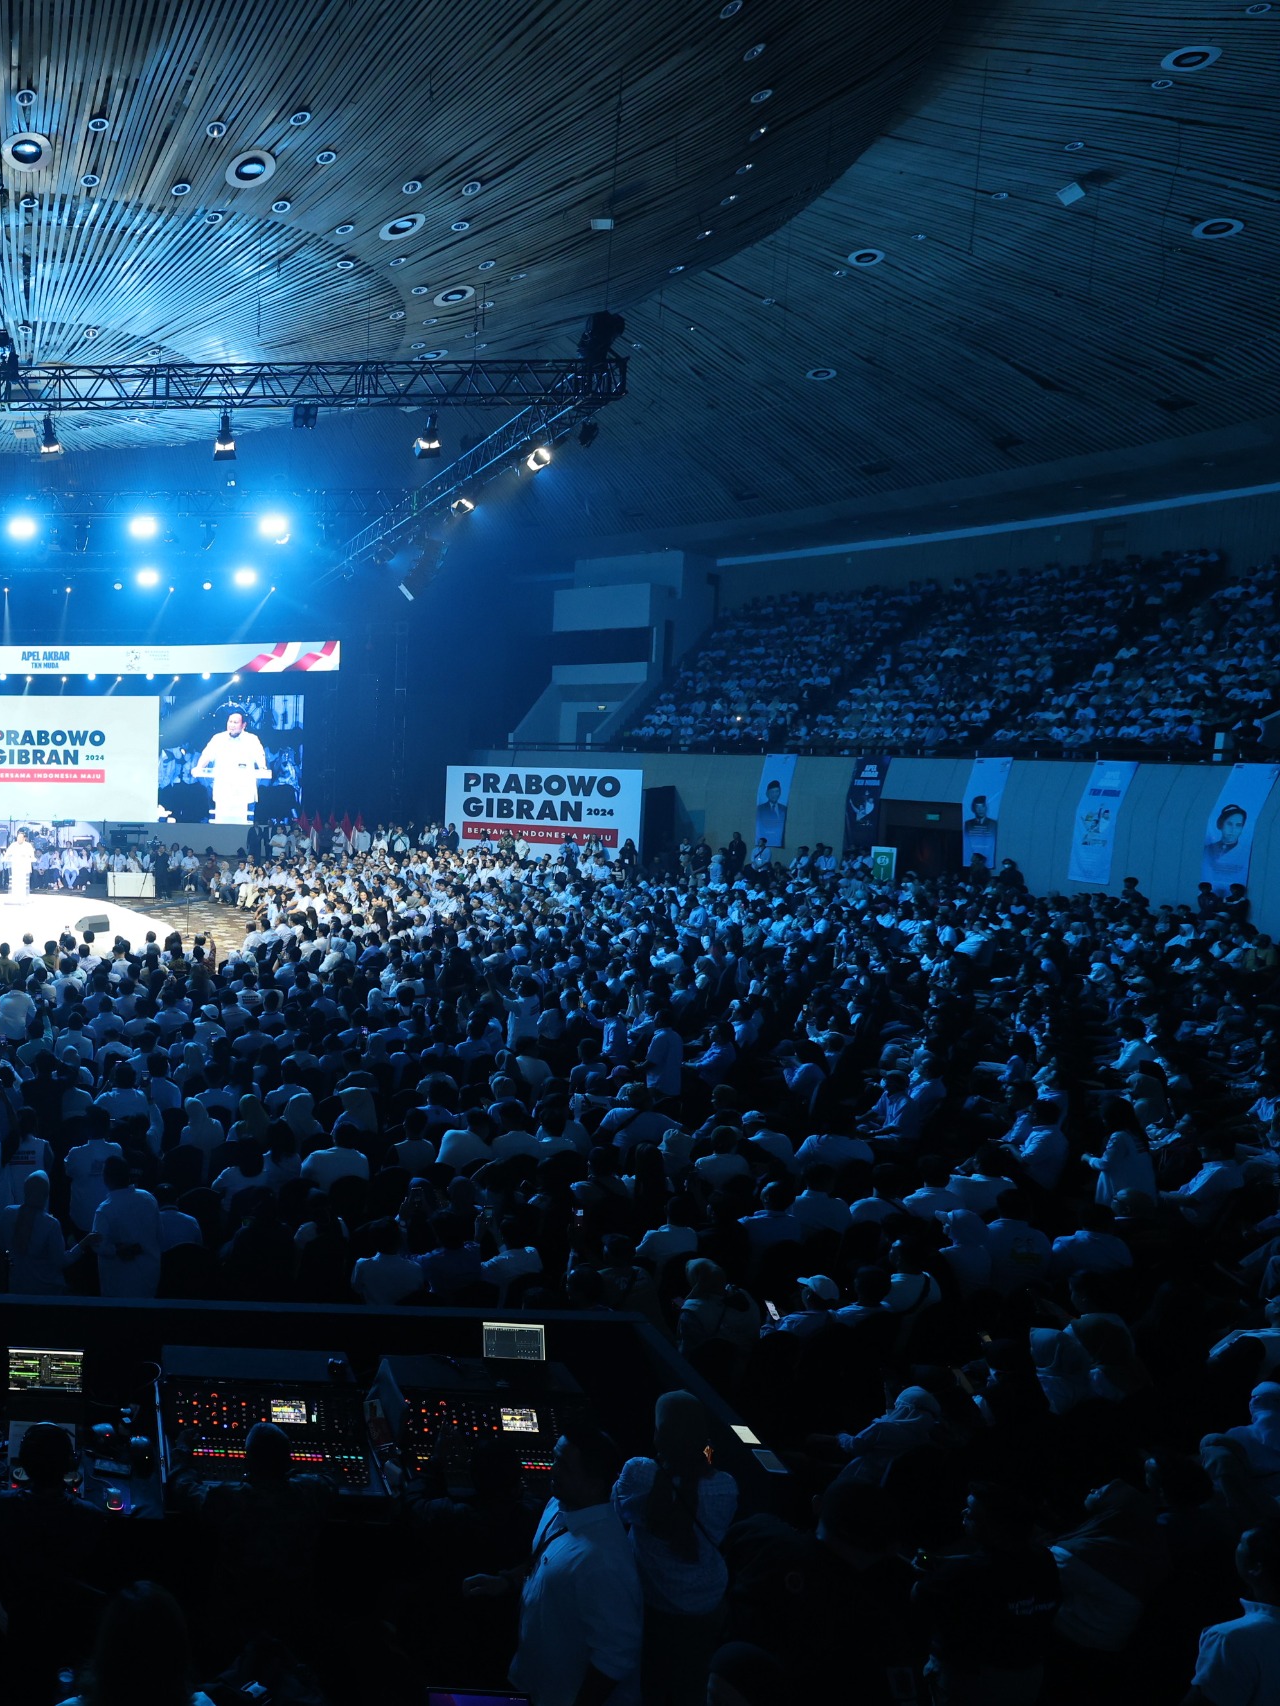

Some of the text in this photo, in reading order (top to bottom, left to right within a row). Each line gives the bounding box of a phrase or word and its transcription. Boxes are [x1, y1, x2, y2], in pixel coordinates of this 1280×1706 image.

[21, 651, 70, 661] APEL AKBAR
[464, 772, 621, 797] PRABOWO
[462, 797, 614, 822] GIBRAN 2024
[582, 833, 612, 842] MJU
